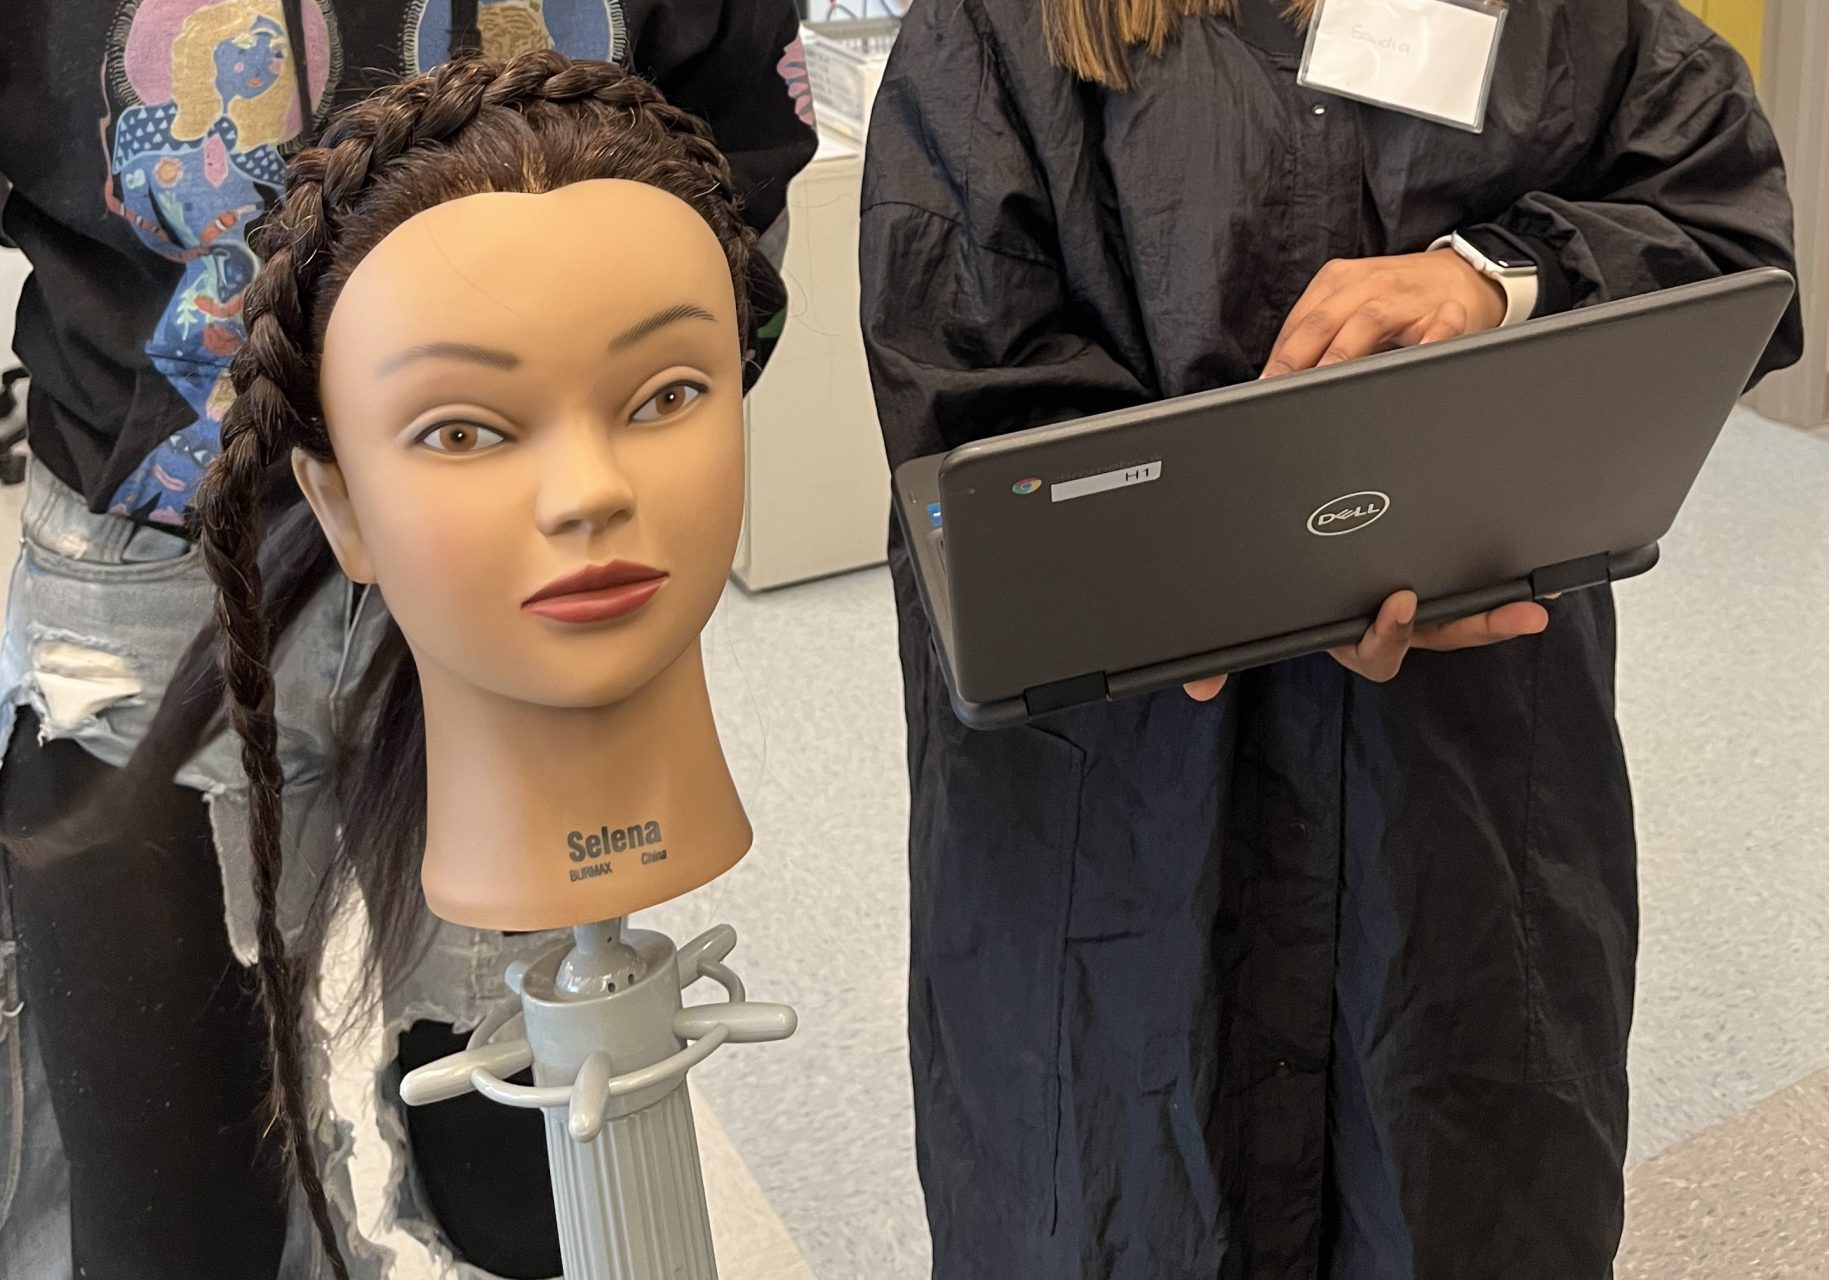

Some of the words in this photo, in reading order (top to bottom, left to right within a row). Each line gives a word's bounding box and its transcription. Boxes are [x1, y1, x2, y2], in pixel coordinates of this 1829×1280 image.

[1125, 468, 1149, 482] H1
[1317, 503, 1380, 526] DELL
[567, 820, 662, 863] Selena
[641, 849, 667, 865] China
